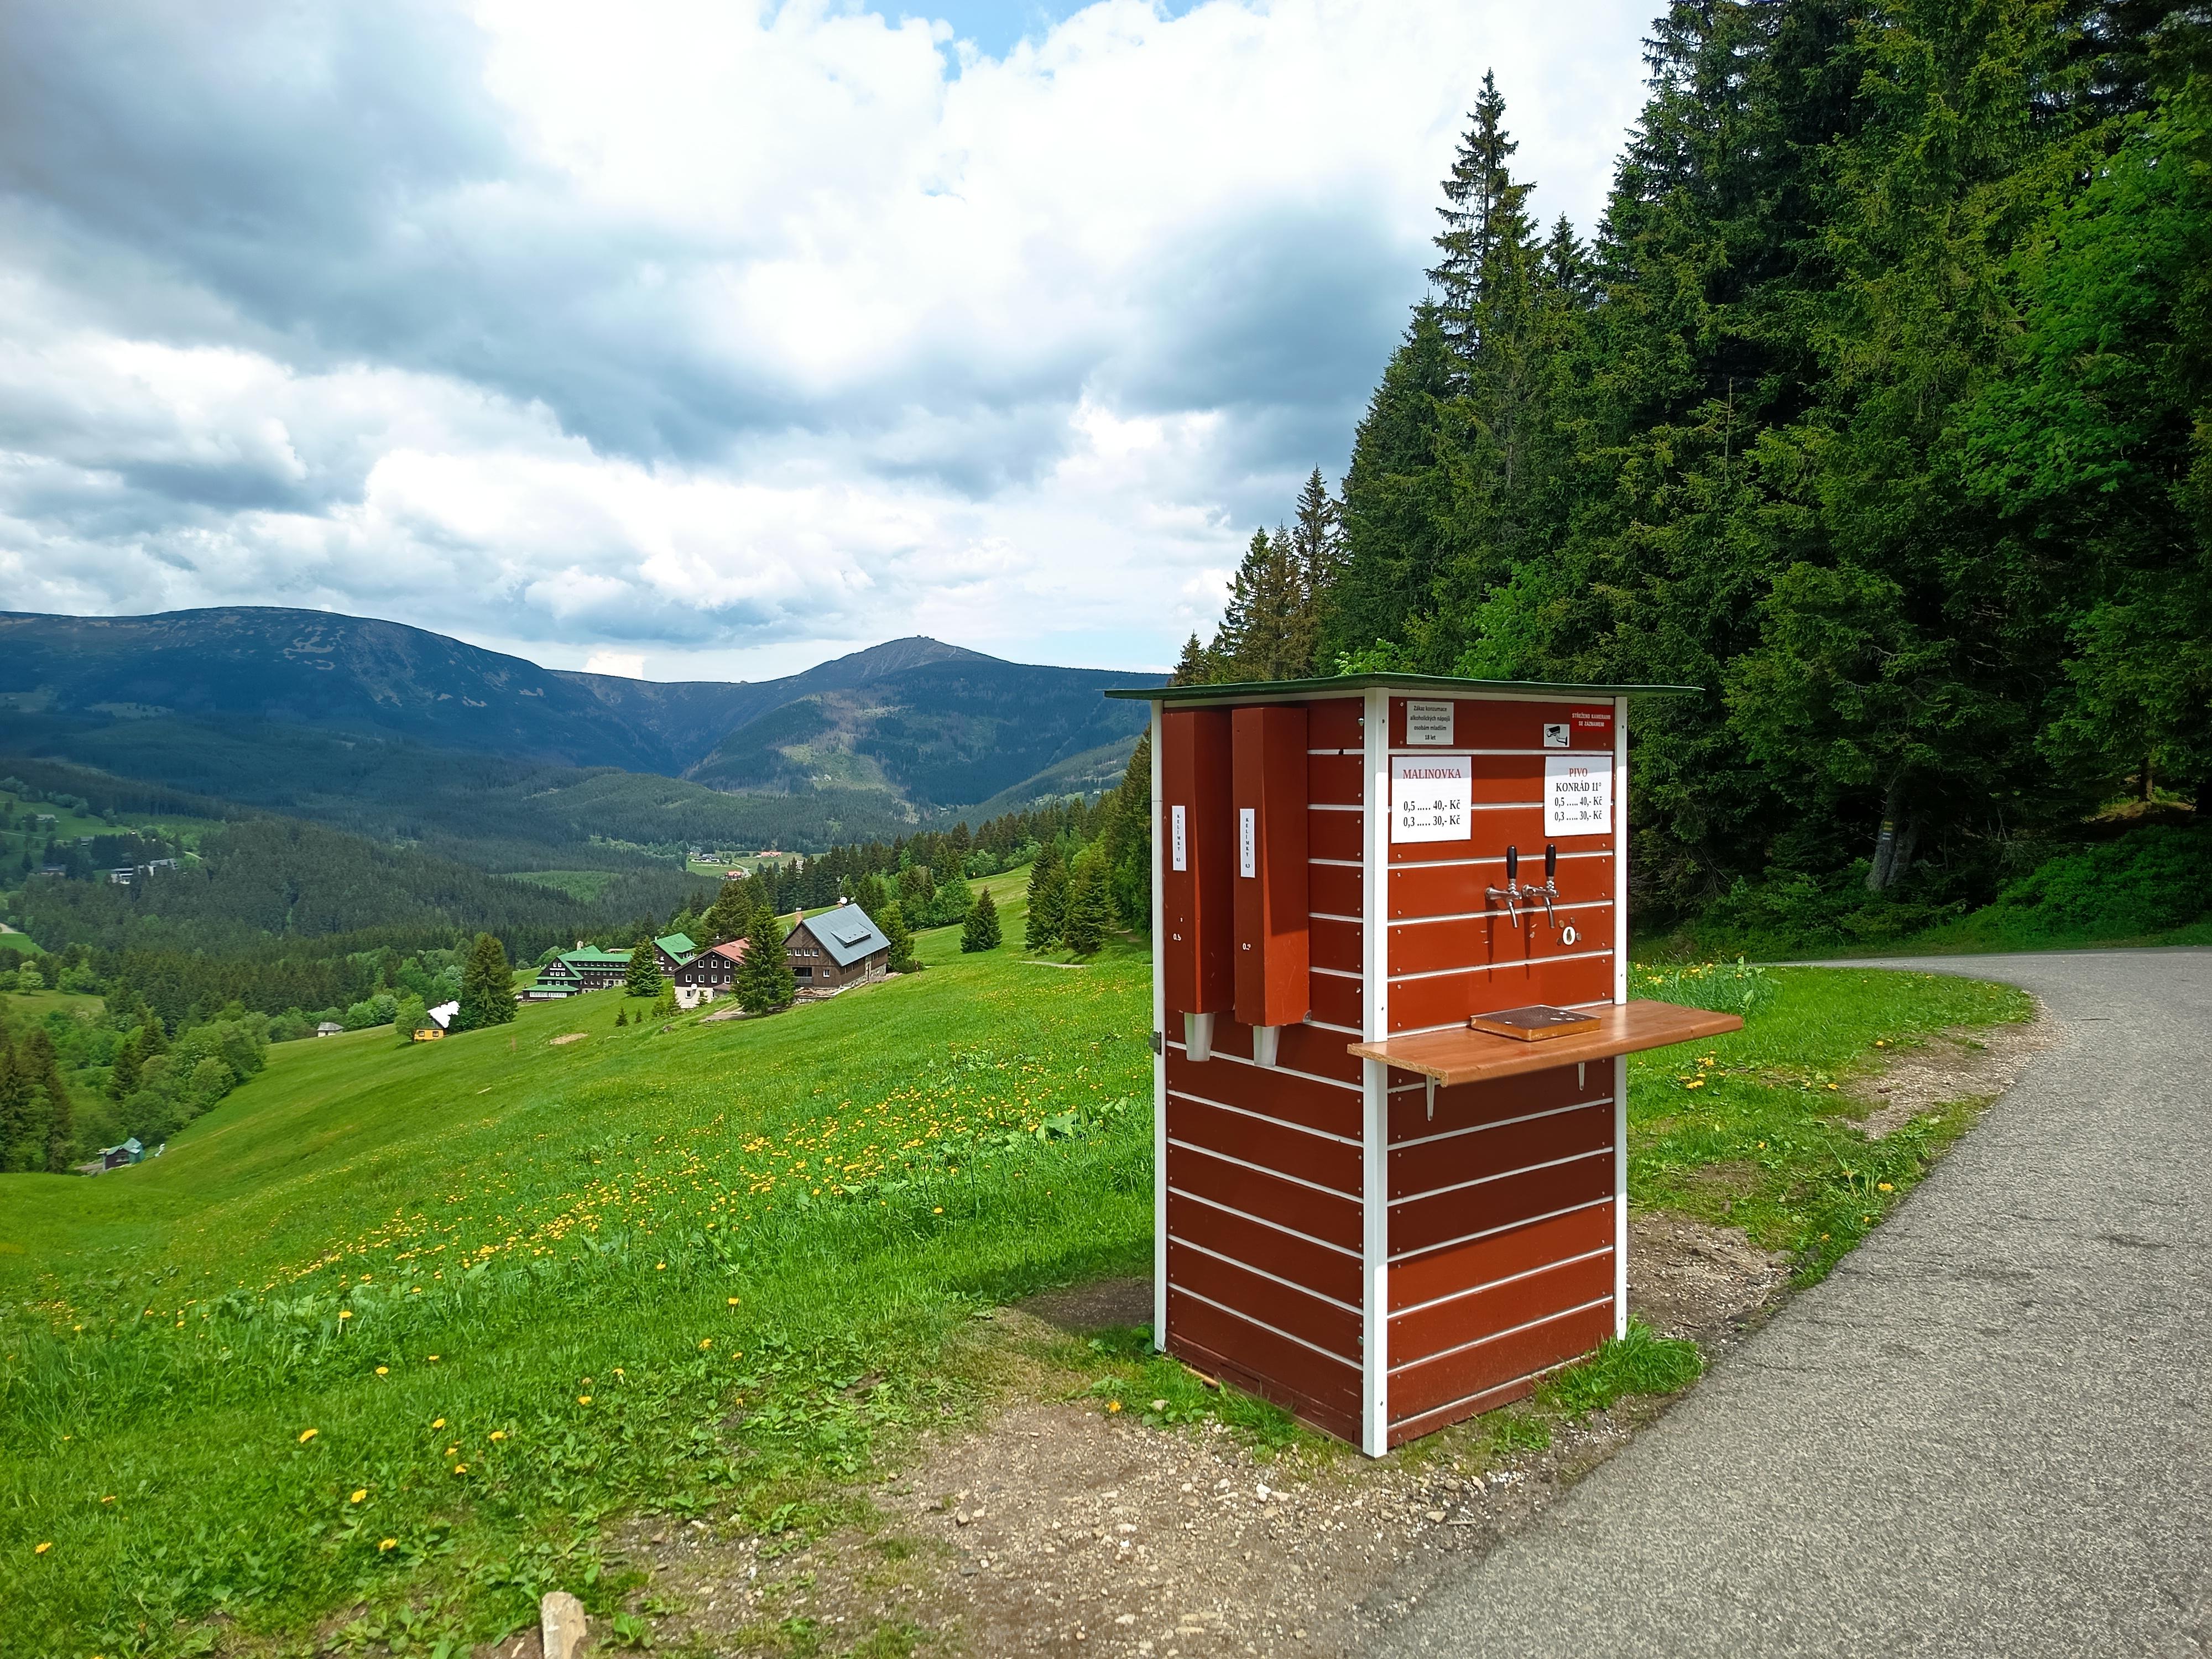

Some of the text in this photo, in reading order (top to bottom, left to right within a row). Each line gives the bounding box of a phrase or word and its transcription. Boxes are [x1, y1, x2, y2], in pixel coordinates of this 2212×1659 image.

[1402, 769, 1462, 779] MALINOVKA
[1569, 768, 1588, 778] PIVO
[1556, 780, 1590, 792] KONRÁD
[1404, 801, 1416, 813] 0,5
[1433, 800, 1448, 812] 40,-
[1449, 799, 1461, 810] Kč
[1554, 797, 1565, 808] 0,5
[1579, 796, 1592, 807] 40,-
[1593, 796, 1603, 806] Kč
[1403, 816, 1415, 828] 0,3
[1433, 816, 1448, 827] 30,-
[1449, 814, 1461, 825] Kč
[1554, 811, 1565, 822] 0,3
[1579, 811, 1592, 822] 30,-
[1593, 810, 1602, 820] Kč
